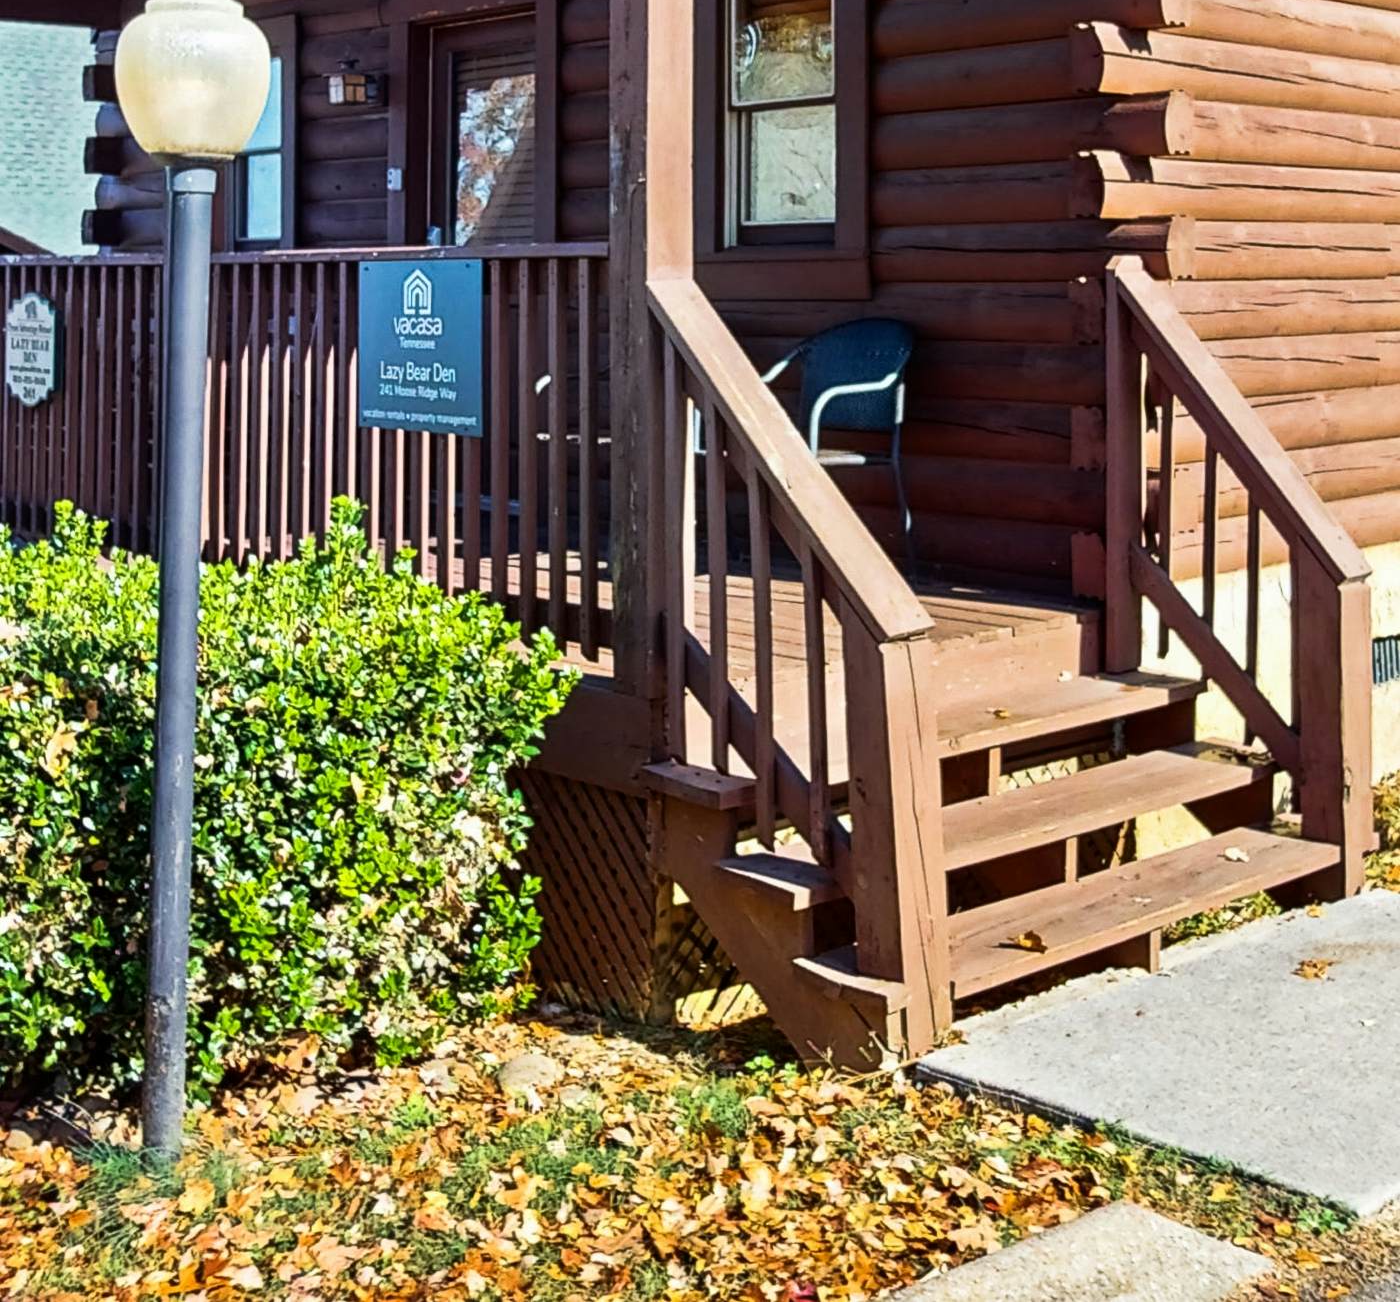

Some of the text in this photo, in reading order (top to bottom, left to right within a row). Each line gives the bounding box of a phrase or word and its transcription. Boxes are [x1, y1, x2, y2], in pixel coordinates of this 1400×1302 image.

[393, 317, 443, 336] vacasa
[10, 338, 30, 350] LAZY
[399, 336, 436, 350] Tennessee
[380, 360, 456, 384] Lazy Bear Den
[379, 383, 457, 402] 241 Moose Ridge Way
